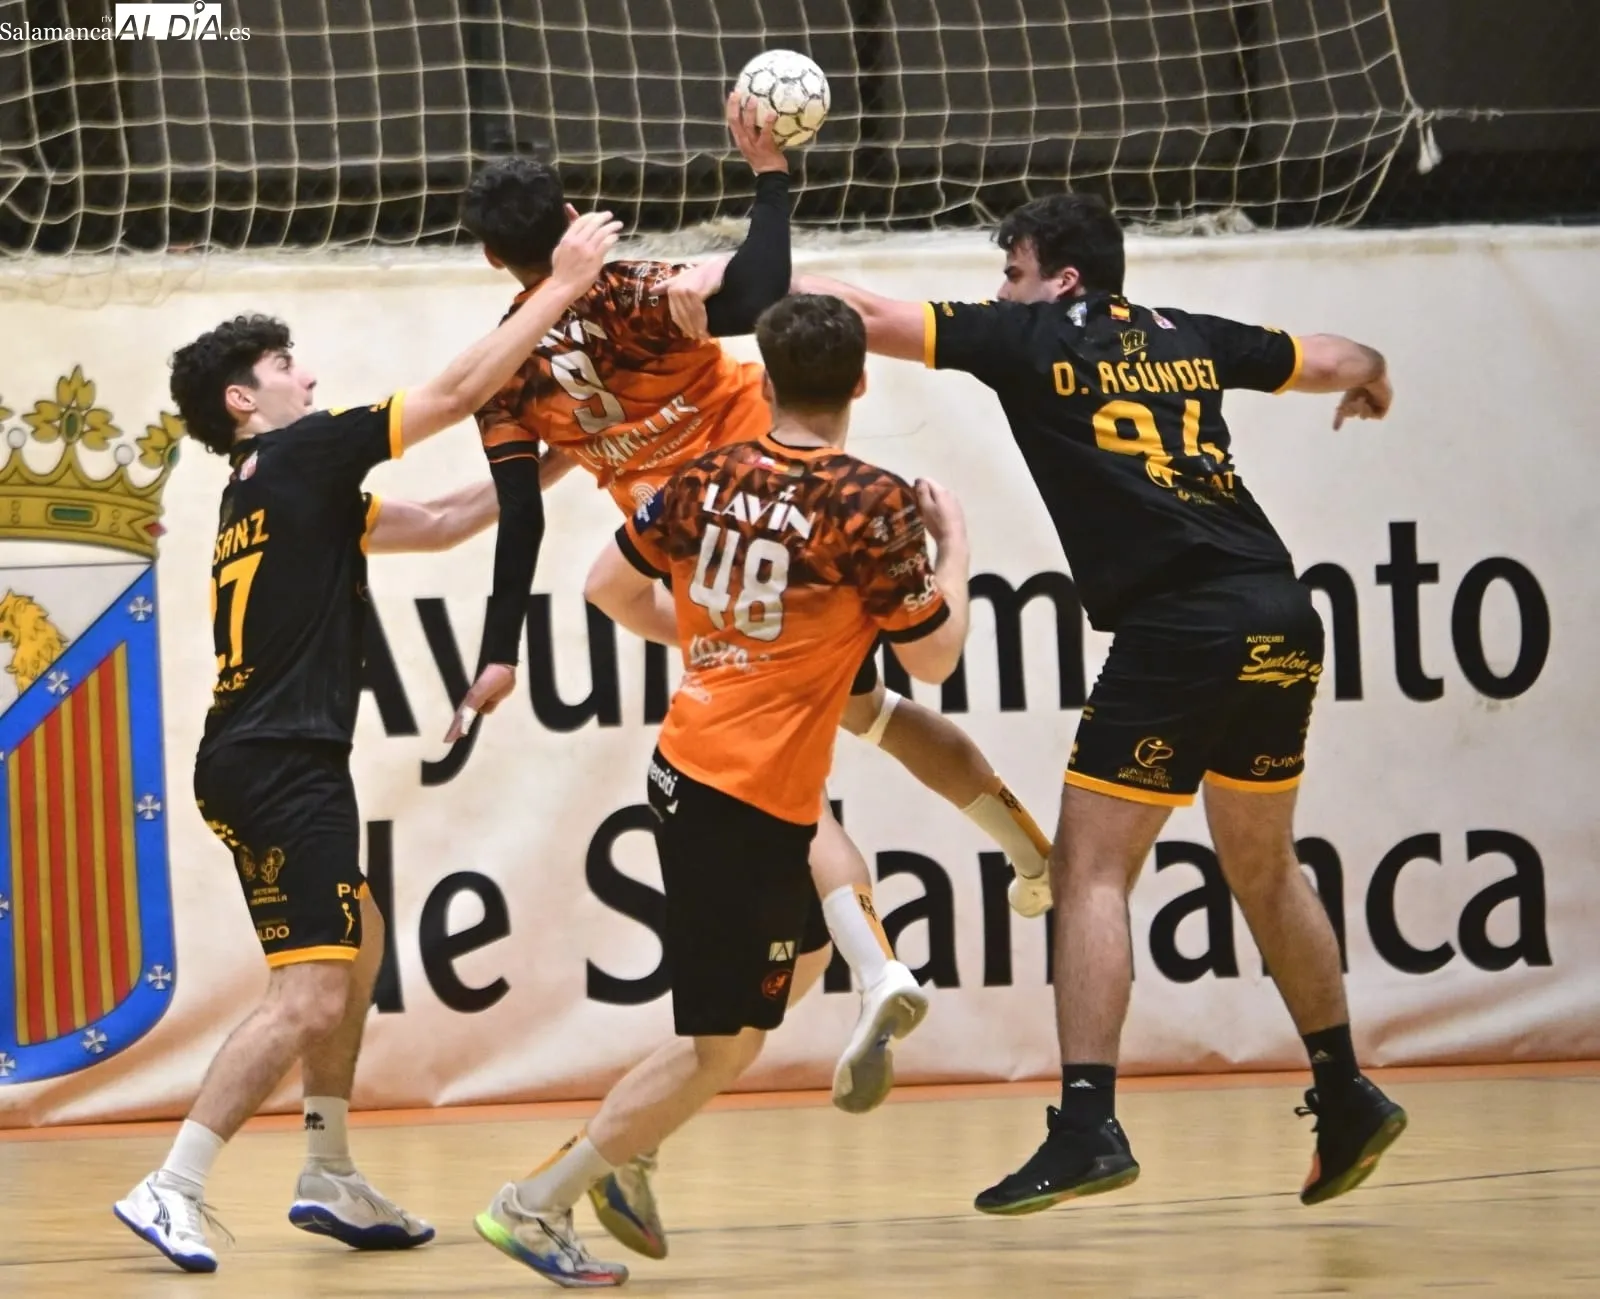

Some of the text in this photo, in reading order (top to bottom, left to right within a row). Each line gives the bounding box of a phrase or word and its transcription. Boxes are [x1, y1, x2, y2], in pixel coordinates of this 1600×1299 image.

[550, 349, 627, 435] 9
[1097, 351, 1220, 394] AGÚNDEZ
[213, 508, 270, 565] SANZ
[702, 483, 817, 540] LAVÍN
[209, 551, 264, 675] 7
[688, 523, 791, 642] 48
[352, 521, 1551, 786] Ayumnto
[586, 800, 1553, 1006] Saanca
